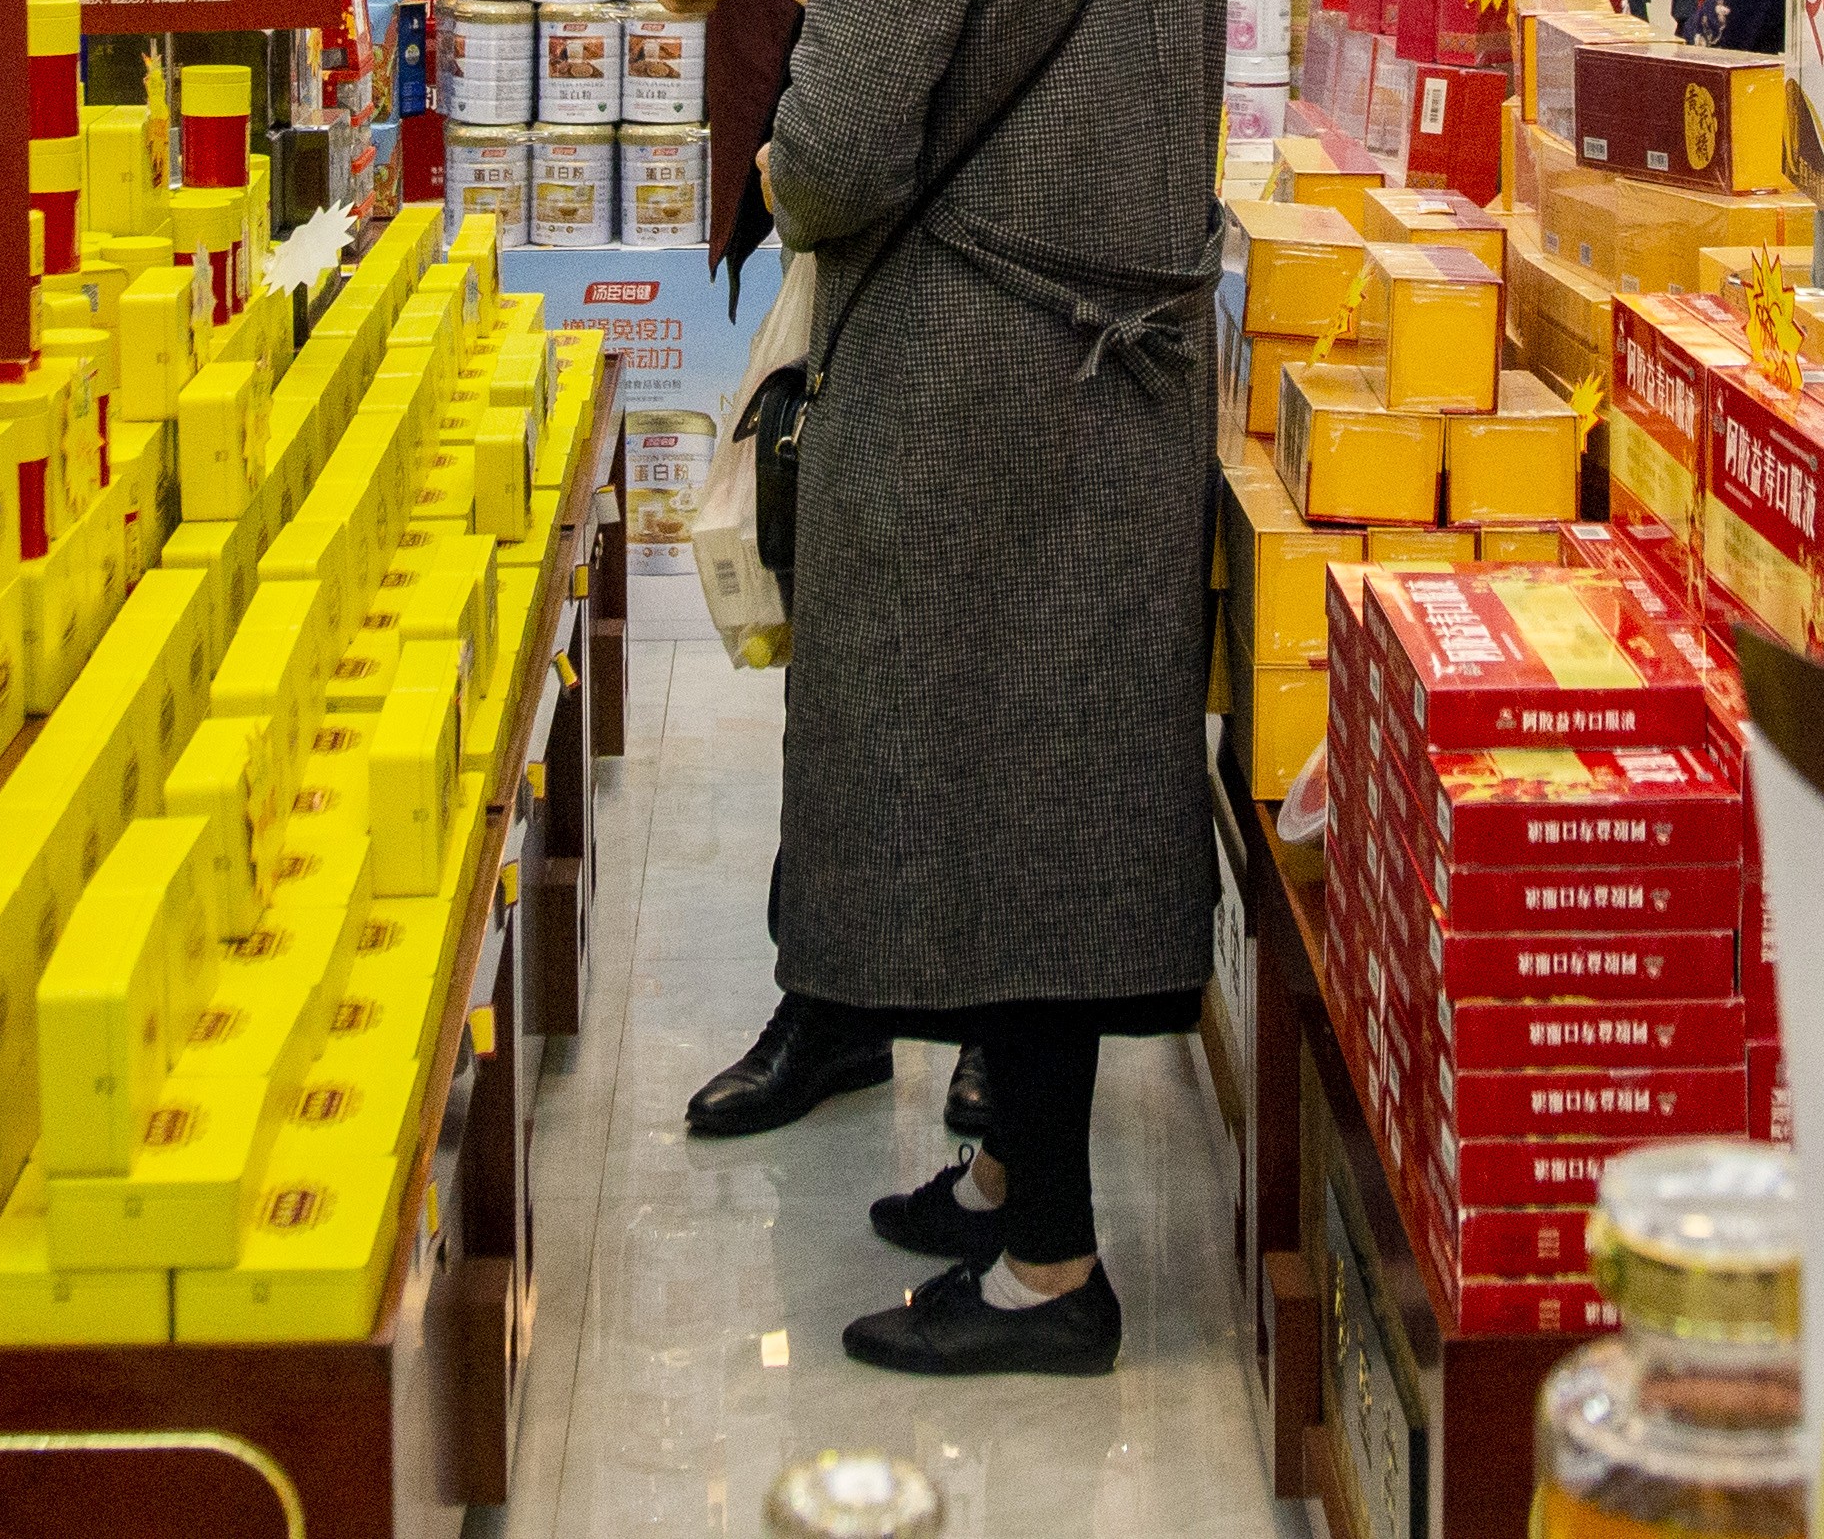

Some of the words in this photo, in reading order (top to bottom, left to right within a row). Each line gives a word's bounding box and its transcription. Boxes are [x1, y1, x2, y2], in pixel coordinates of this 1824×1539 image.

[474, 168, 515, 182] 蛋白粉
[545, 166, 586, 180] 蛋白粉
[646, 166, 687, 181] 蛋白粉
[593, 285, 653, 302] 汤臣倍健
[1625, 334, 1697, 443] 阿胶益寿口服液
[634, 464, 689, 482] 蛋白粉
[1724, 414, 1818, 542] 阿胶益寿口服液
[1522, 710, 1637, 732] 阿胶益寿口服液
[1528, 819, 1647, 843] 阿胶益寿口服液
[1525, 886, 1644, 910] 阿胶益寿口服液
[1518, 952, 1637, 976] 阿胶益寿口服液
[1529, 1022, 1648, 1046] 阿胶益寿口服液
[1531, 1089, 1651, 1114] 阿胶益寿口服液
